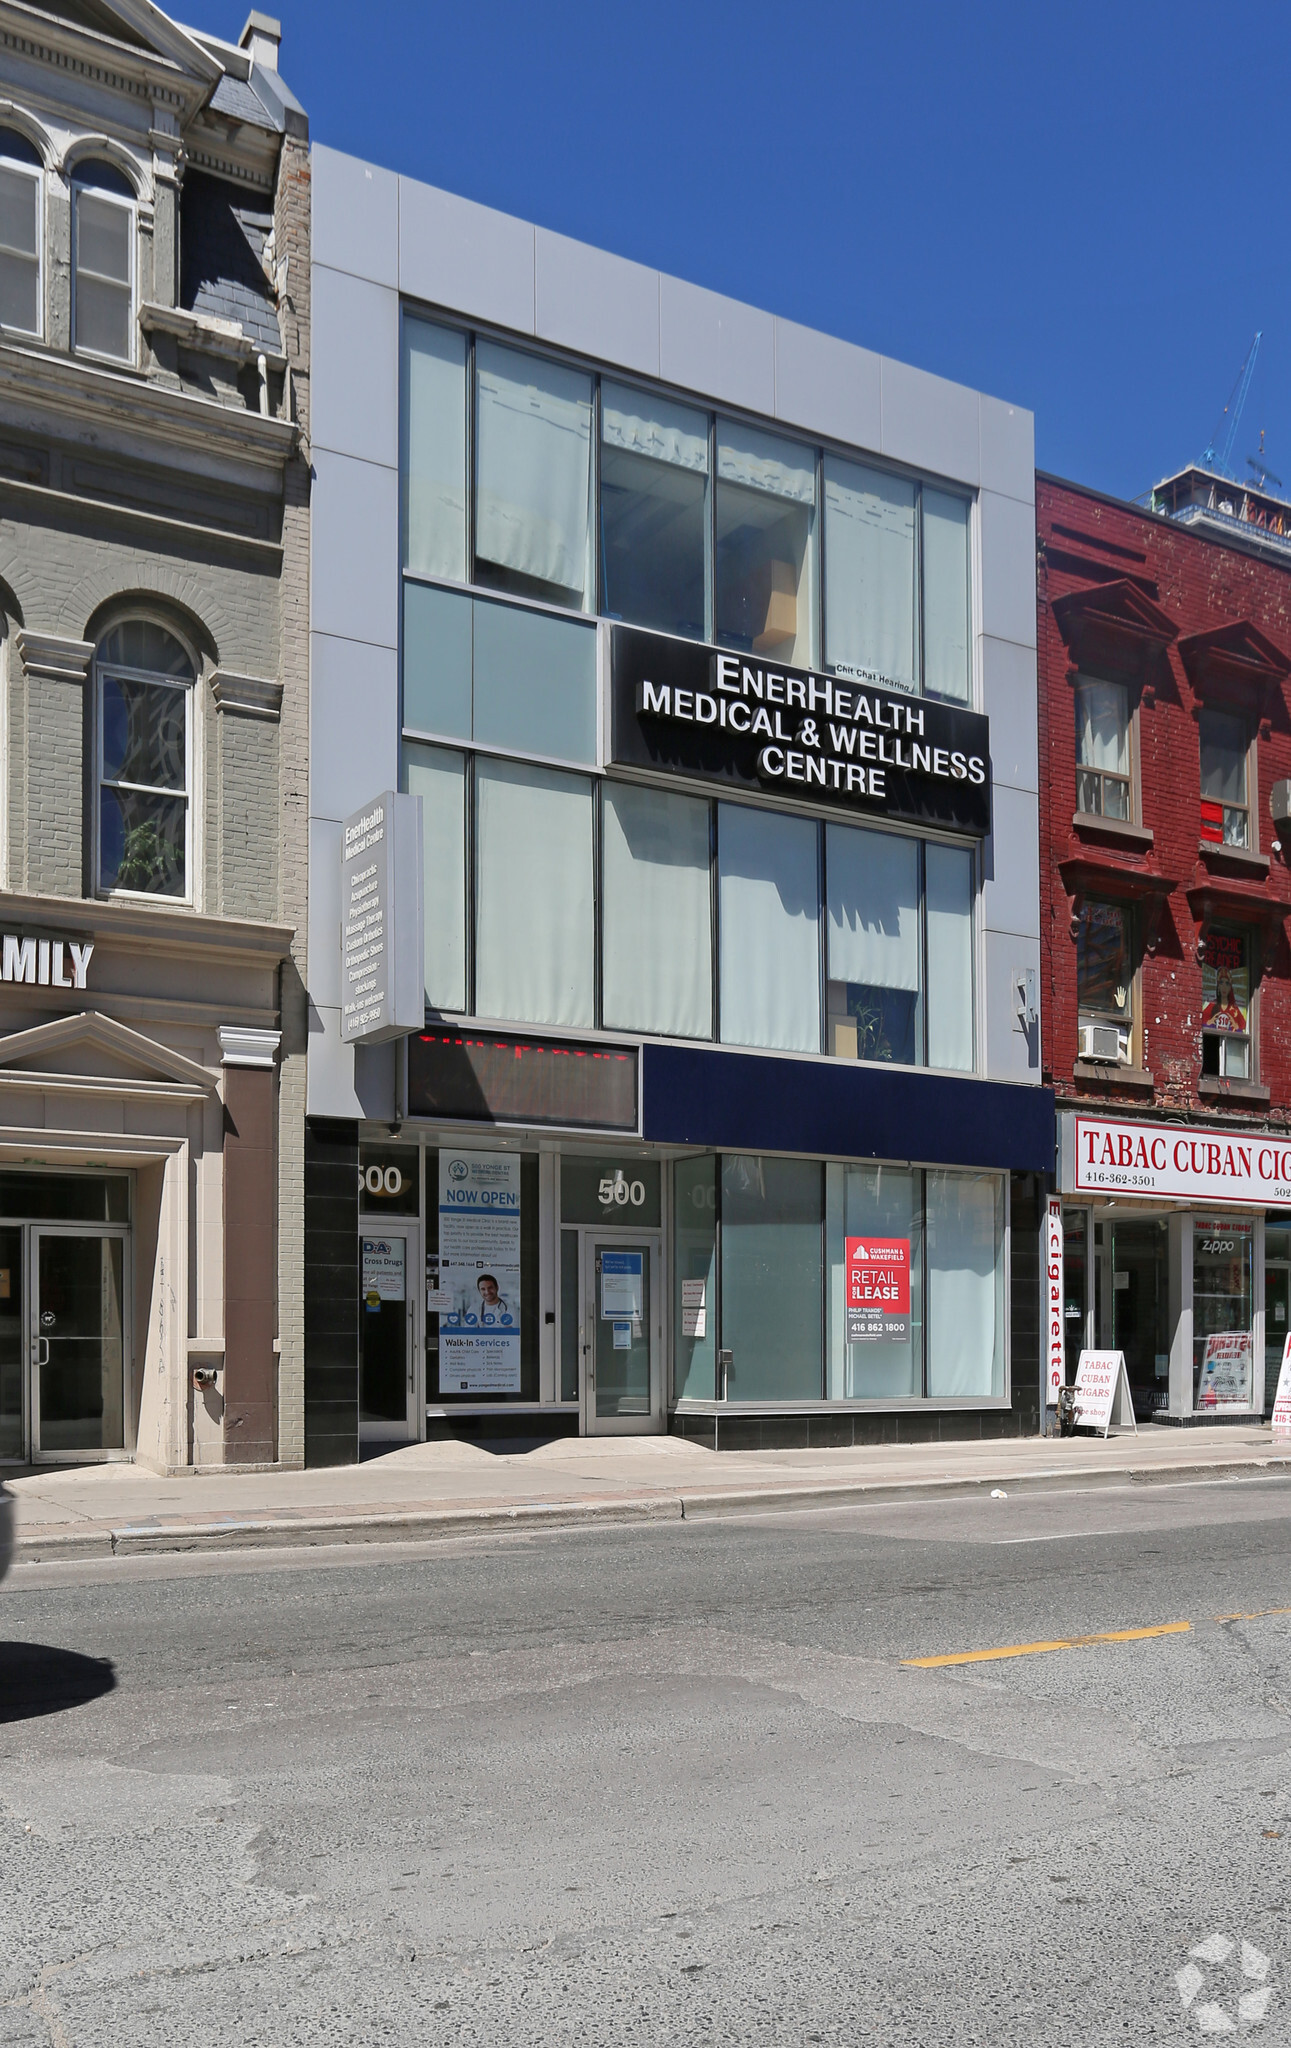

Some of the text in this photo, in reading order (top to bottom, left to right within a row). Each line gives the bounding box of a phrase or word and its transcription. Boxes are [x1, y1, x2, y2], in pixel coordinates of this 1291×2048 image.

[836, 663, 909, 692] Chit Chat Hearing
[642, 681, 985, 784] MEDICAL & WELLNESS
[763, 746, 886, 797] CENTRE
[346, 806, 384, 845] EnerHealth
[346, 828, 384, 861] Medical Centre
[351, 864, 377, 887] Chiropractic
[351, 880, 378, 902] Acupuncture
[349, 896, 379, 920] Physiotherapy
[345, 911, 383, 937] Massage Therapy
[346, 926, 383, 952] Custom Orthotics
[1206, 934, 1242, 954] PSYCHIC
[0, 934, 95, 989] MILY
[346, 942, 384, 968] Orthopedic Shoes
[1205, 951, 1240, 968] READER
[355, 979, 377, 996] stockings
[344, 991, 385, 1016] Walk-ins welcome
[1083, 1131, 1166, 1170] TABAC
[1173, 1140, 1252, 1178] CUBAN
[1085, 1171, 1155, 1187] 416-362-3501
[447, 1189, 515, 1205] NOW OPEN
[598, 1179, 645, 1206] 500
[384, 1258, 403, 1267] Drugs
[851, 1270, 898, 1284] RETAIL
[857, 1286, 899, 1300] LEASE
[851, 1323, 905, 1332] 416 862 1800
[445, 1339, 510, 1347] Walk-In Services
[1085, 1360, 1113, 1370] TABAC
[1081, 1374, 1111, 1383] CUBAN
[1076, 1387, 1110, 1397] CIGARS
[1090, 1408, 1106, 1418] shop
